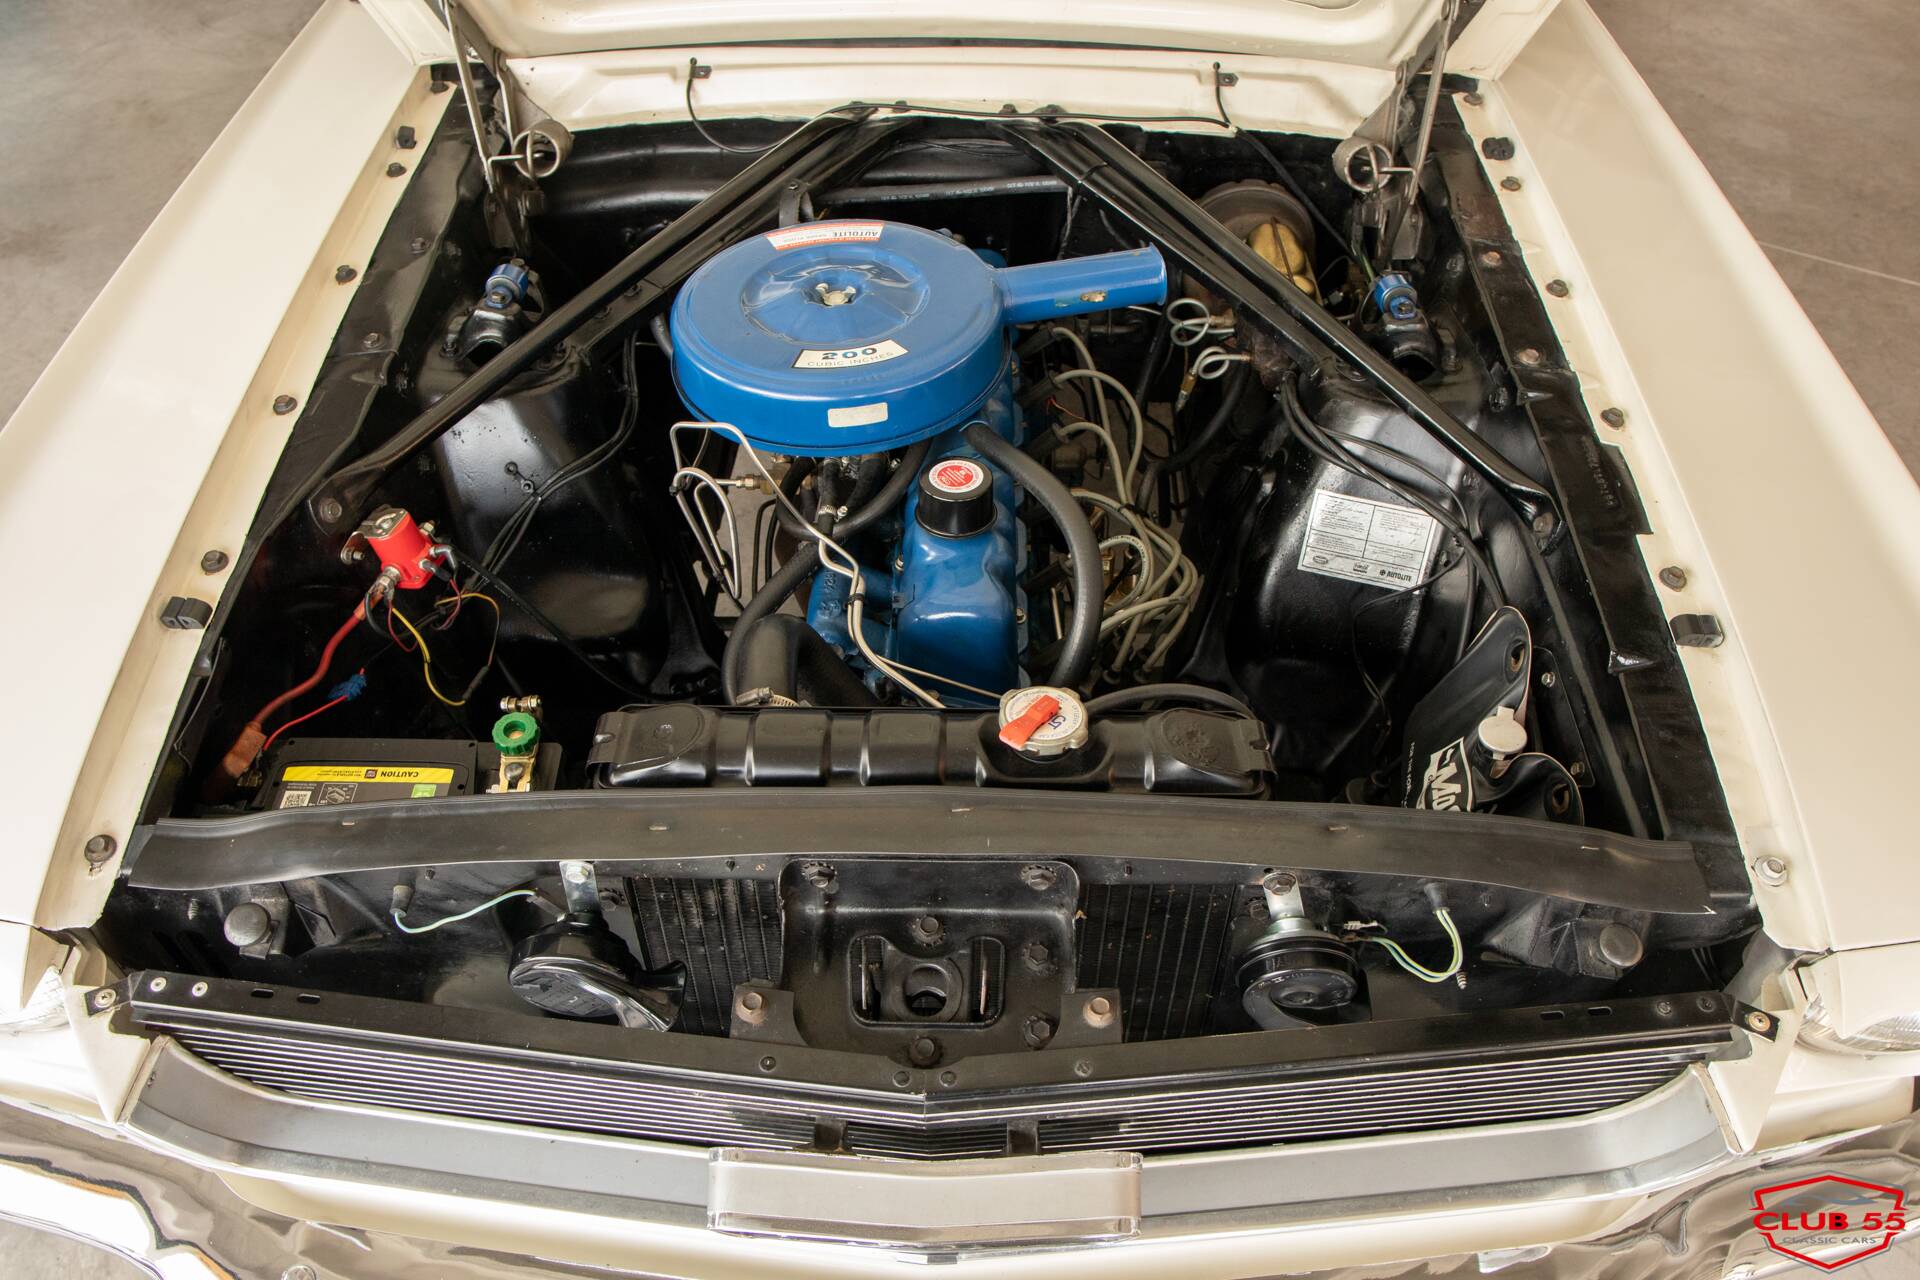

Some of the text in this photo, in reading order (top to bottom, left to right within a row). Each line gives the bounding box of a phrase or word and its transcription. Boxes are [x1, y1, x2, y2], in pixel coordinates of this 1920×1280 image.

[821, 347, 878, 360] 200
[849, 352, 895, 365] INCHES
[1386, 570, 1413, 582] AUTOLITE
[380, 770, 419, 778] CAUTION
